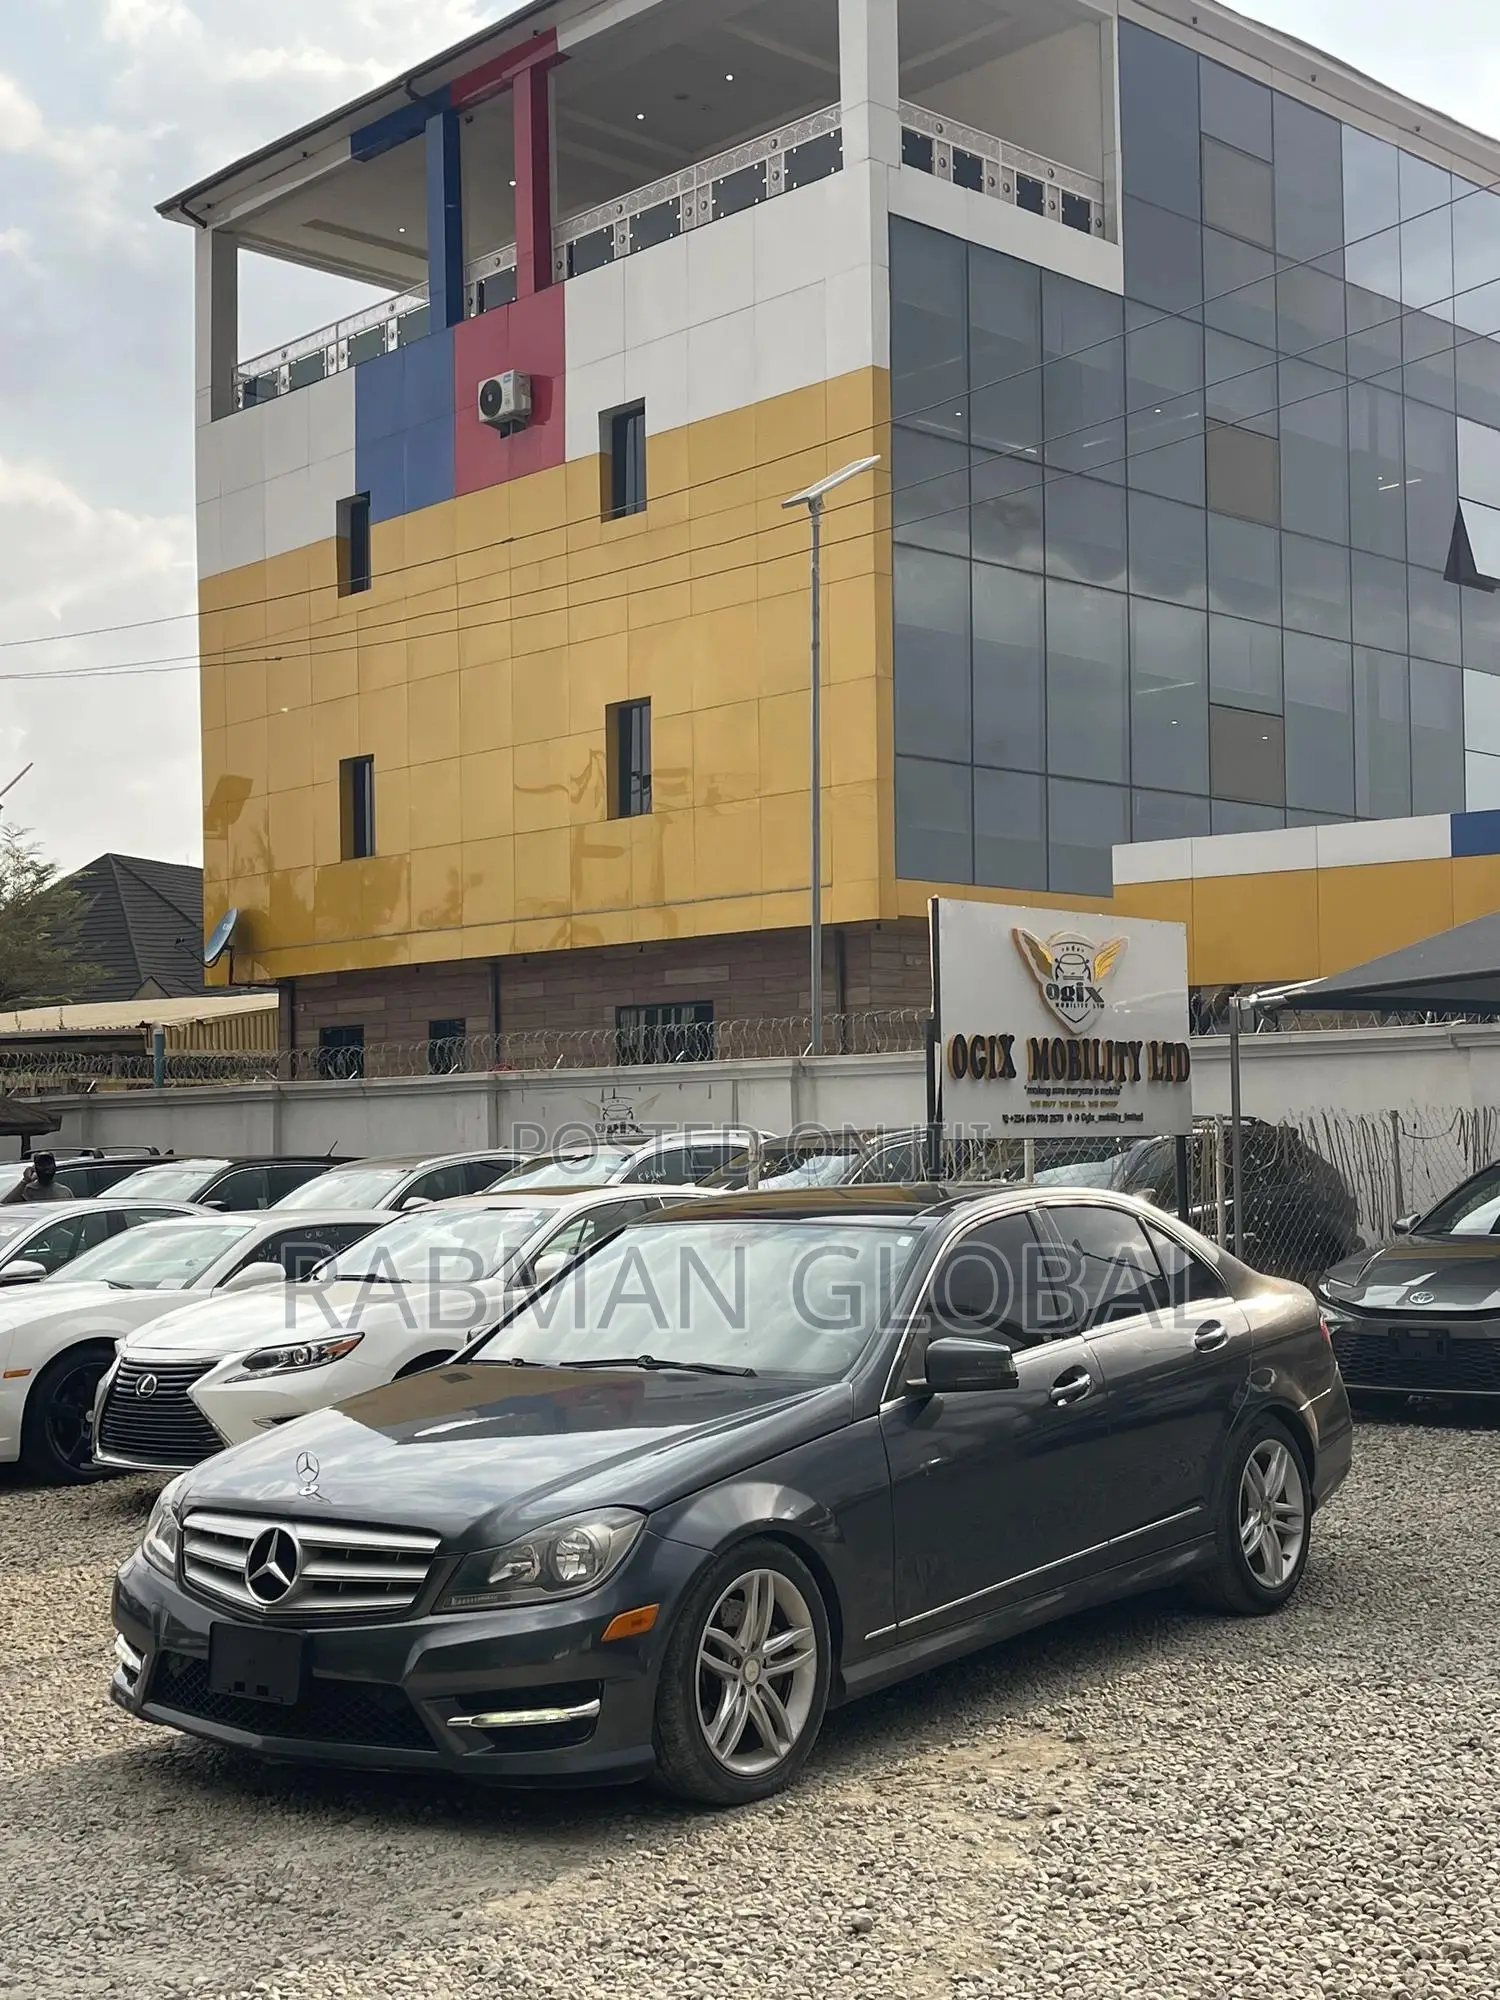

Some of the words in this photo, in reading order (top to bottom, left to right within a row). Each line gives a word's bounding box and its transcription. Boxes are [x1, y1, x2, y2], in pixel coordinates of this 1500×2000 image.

[948, 1033, 1017, 1080] OGIX
[1026, 1037, 1143, 1083] MOBILITY
[1146, 1040, 1190, 1082] LTD
